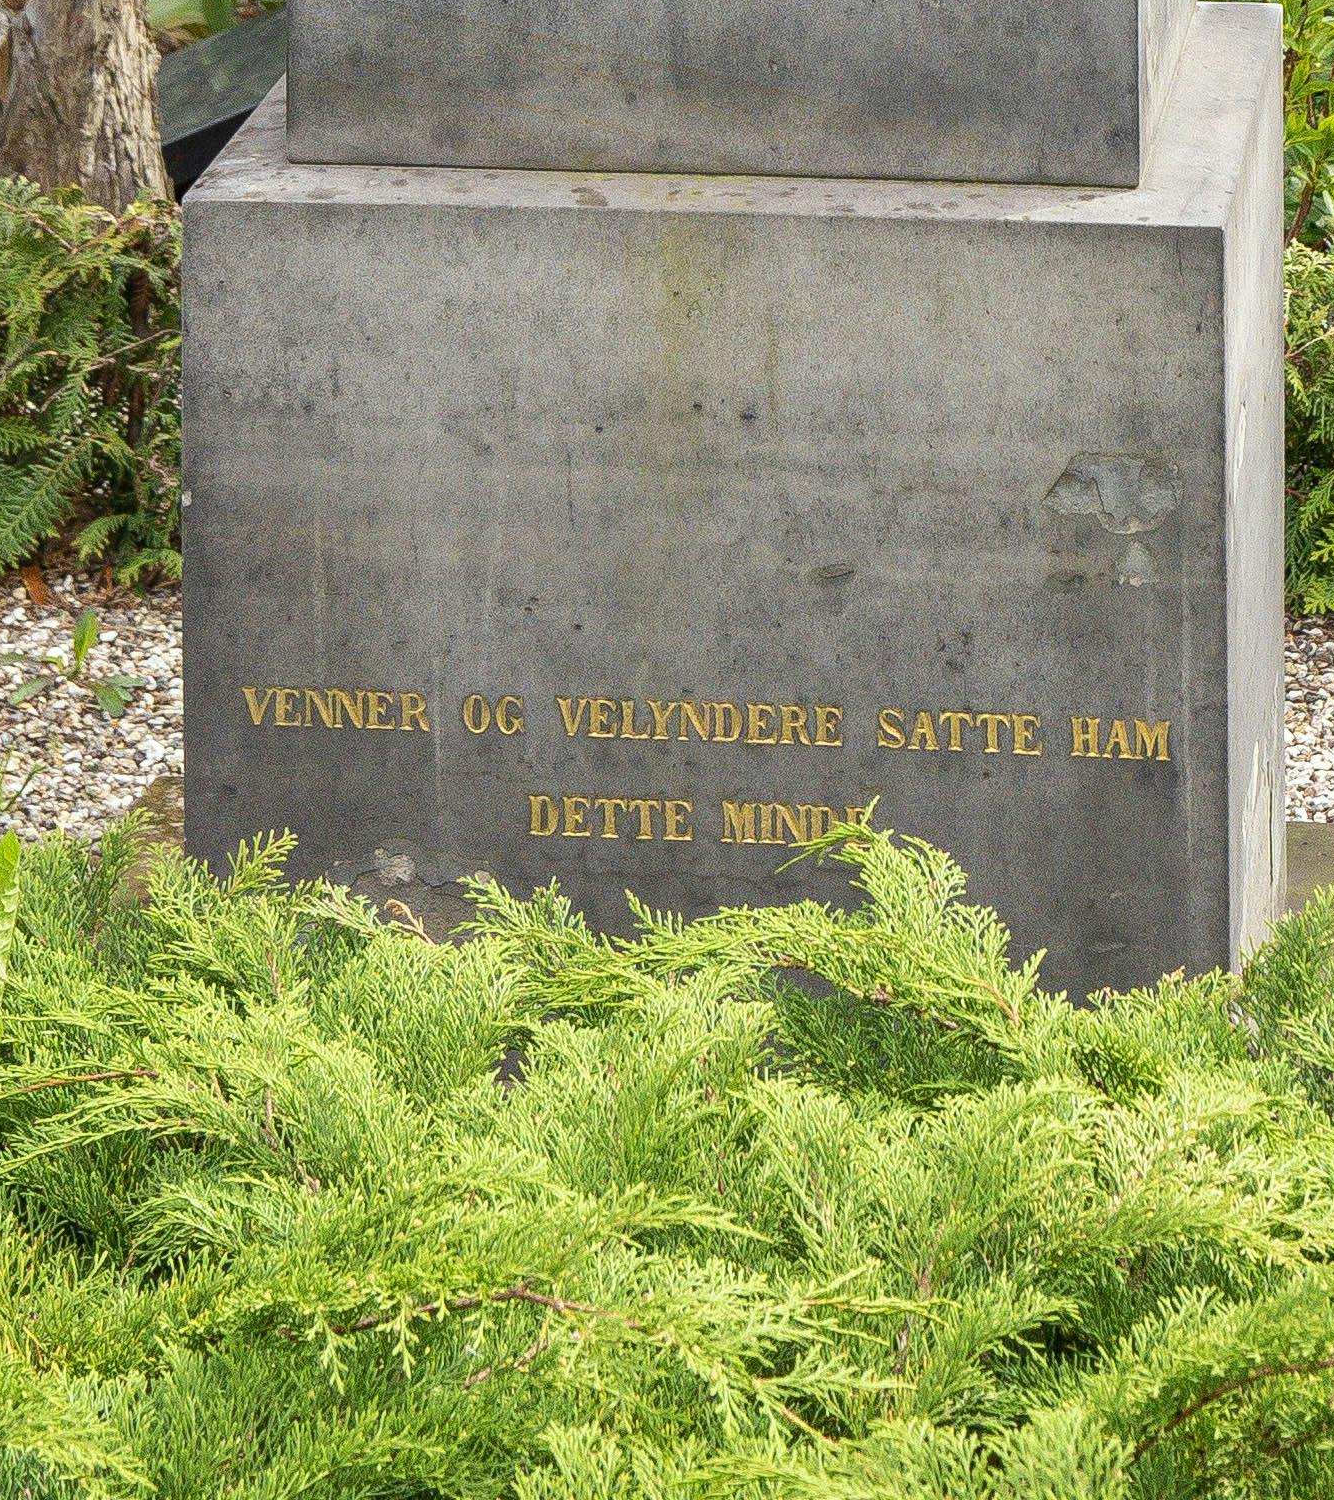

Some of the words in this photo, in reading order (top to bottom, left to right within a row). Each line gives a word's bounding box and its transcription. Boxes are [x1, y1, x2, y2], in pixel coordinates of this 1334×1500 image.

[242, 684, 431, 733] VENNER
[462, 694, 525, 736] OG
[556, 695, 844, 748] VELYNDERE
[875, 707, 1045, 757] SATTE
[1070, 714, 1171, 763] HAM
[527, 794, 695, 843] DETTE
